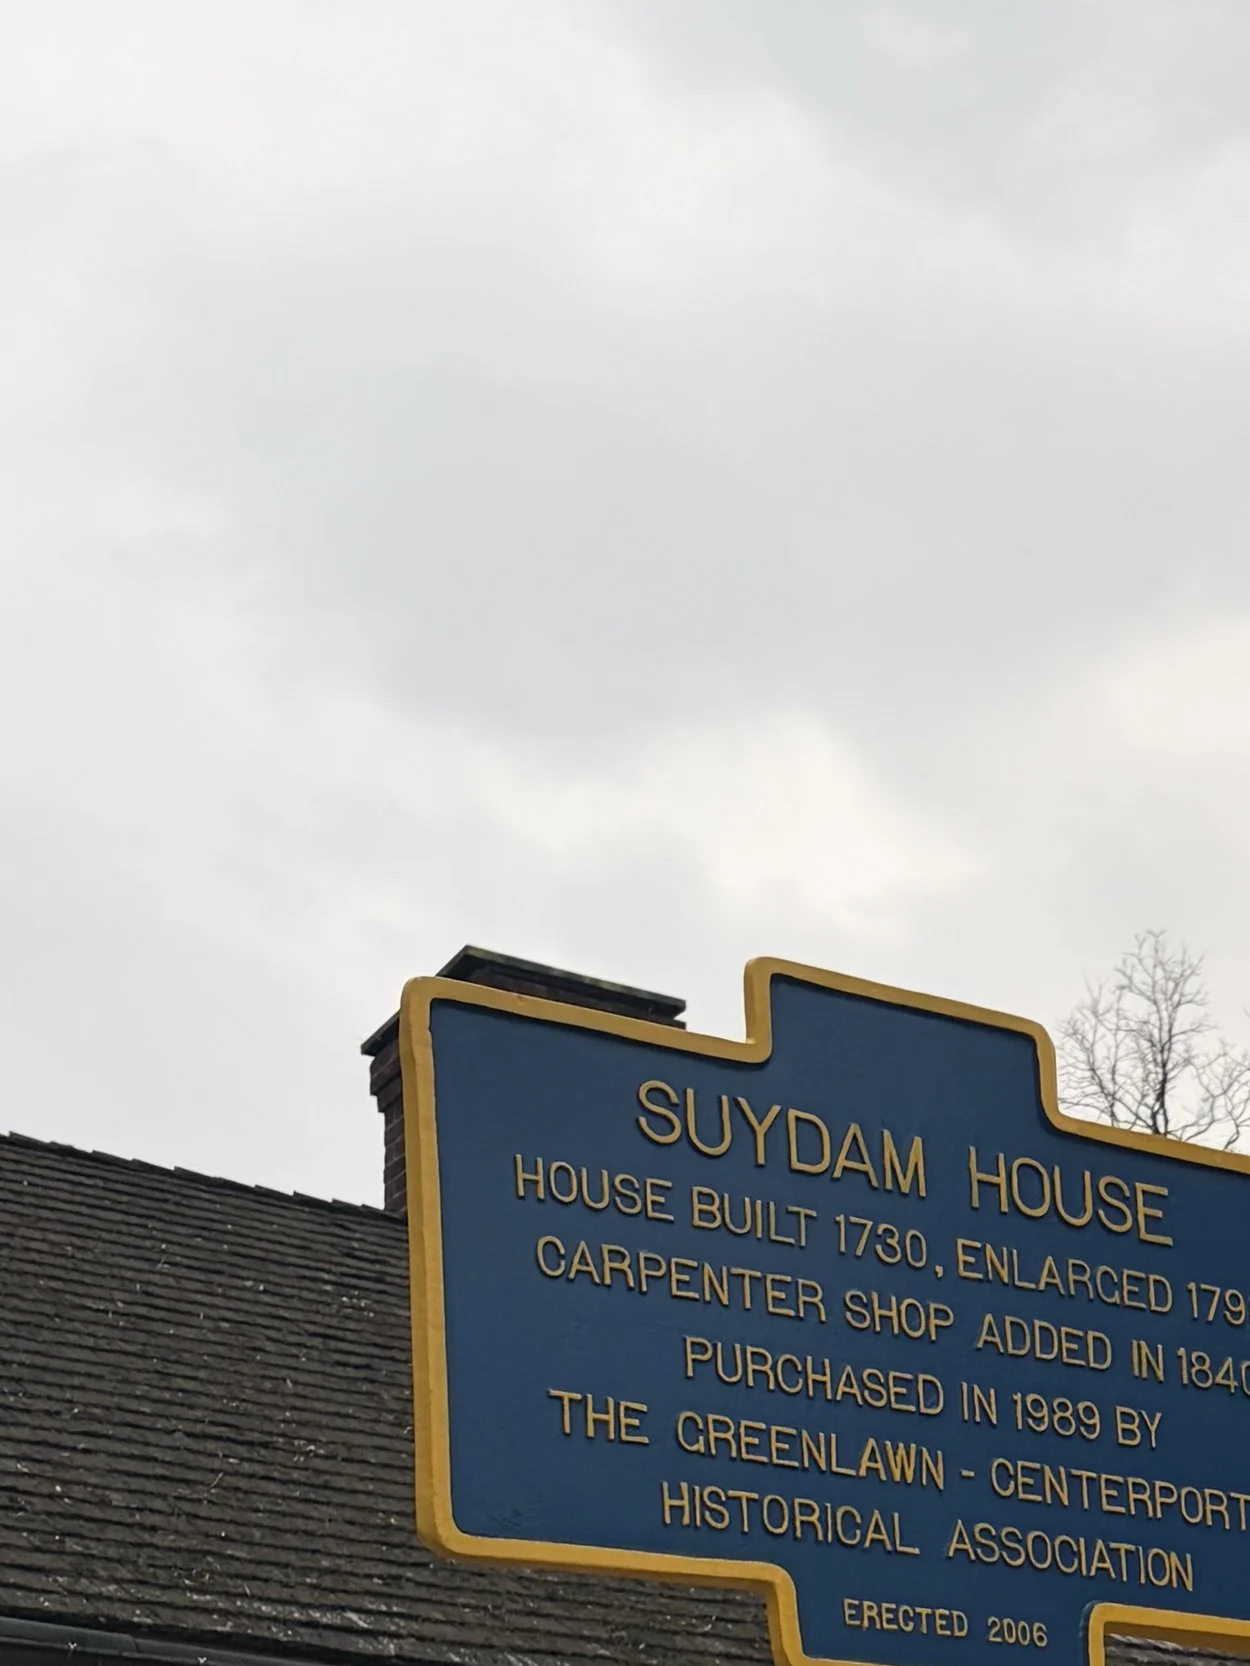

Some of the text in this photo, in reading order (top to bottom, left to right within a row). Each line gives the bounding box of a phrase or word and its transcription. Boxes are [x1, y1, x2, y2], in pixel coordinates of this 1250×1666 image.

[638, 1080, 1173, 1246] SUYDAM HOUSE
[515, 1154, 674, 1220] HOUSE
[691, 1186, 816, 1246] BUILT
[956, 1239, 1172, 1313] ENLARGED
[536, 1236, 826, 1321] CARPENTER
[844, 1292, 953, 1340] SHOP
[977, 1315, 1111, 1369] ADDED
[1132, 1341, 1164, 1381] IN
[549, 1388, 649, 1444] THE
[676, 1411, 943, 1489] GREENLAWN
[685, 1338, 1160, 1446] PURCHASED IN 1989 BY
[662, 1481, 1193, 1591] HISTORICAL ASSOCIATION
[844, 1599, 1046, 1647] ERECTED 2006
